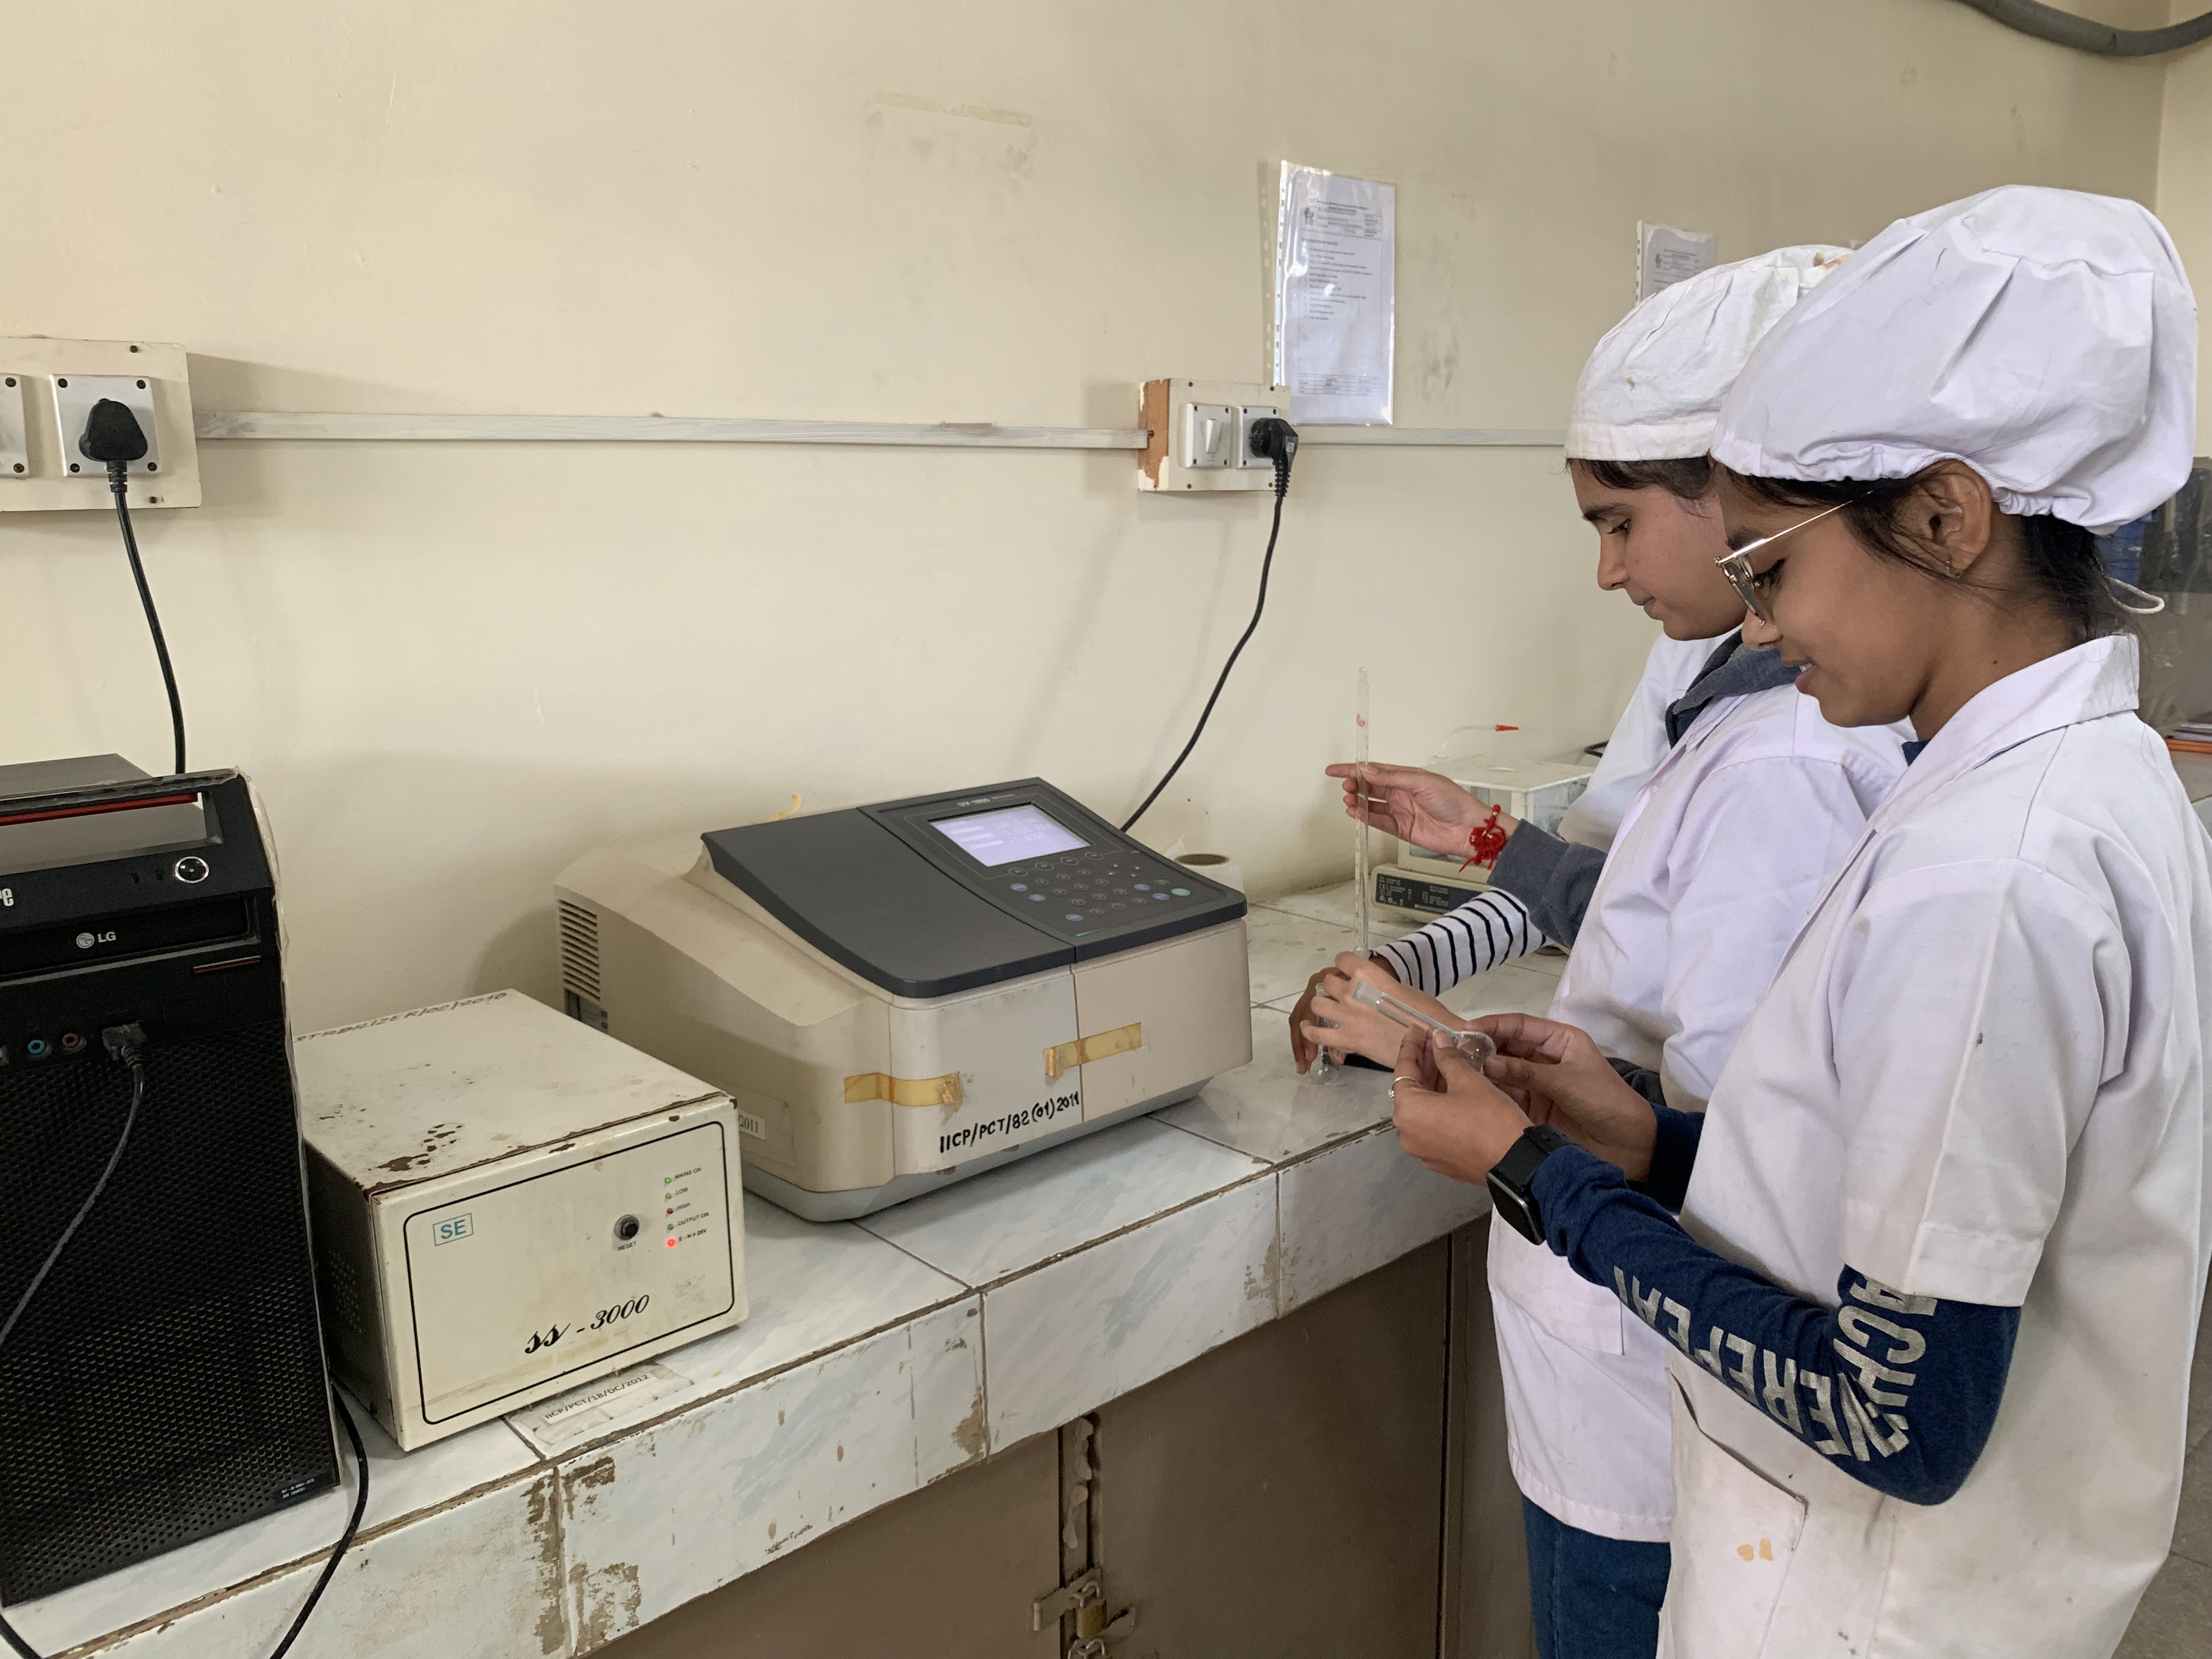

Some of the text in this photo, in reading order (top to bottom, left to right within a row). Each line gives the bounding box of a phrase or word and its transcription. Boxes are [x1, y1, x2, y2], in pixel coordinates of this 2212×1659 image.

[97, 931, 116, 943] LG
[674, 1170, 692, 1180] MAINS
[676, 1202, 691, 1210] HIGH
[678, 1215, 699, 1226] OUTPUT
[441, 1218, 467, 1239] SE
[618, 1241, 637, 1251] RESET
[590, 1294, 650, 1330] 3000
